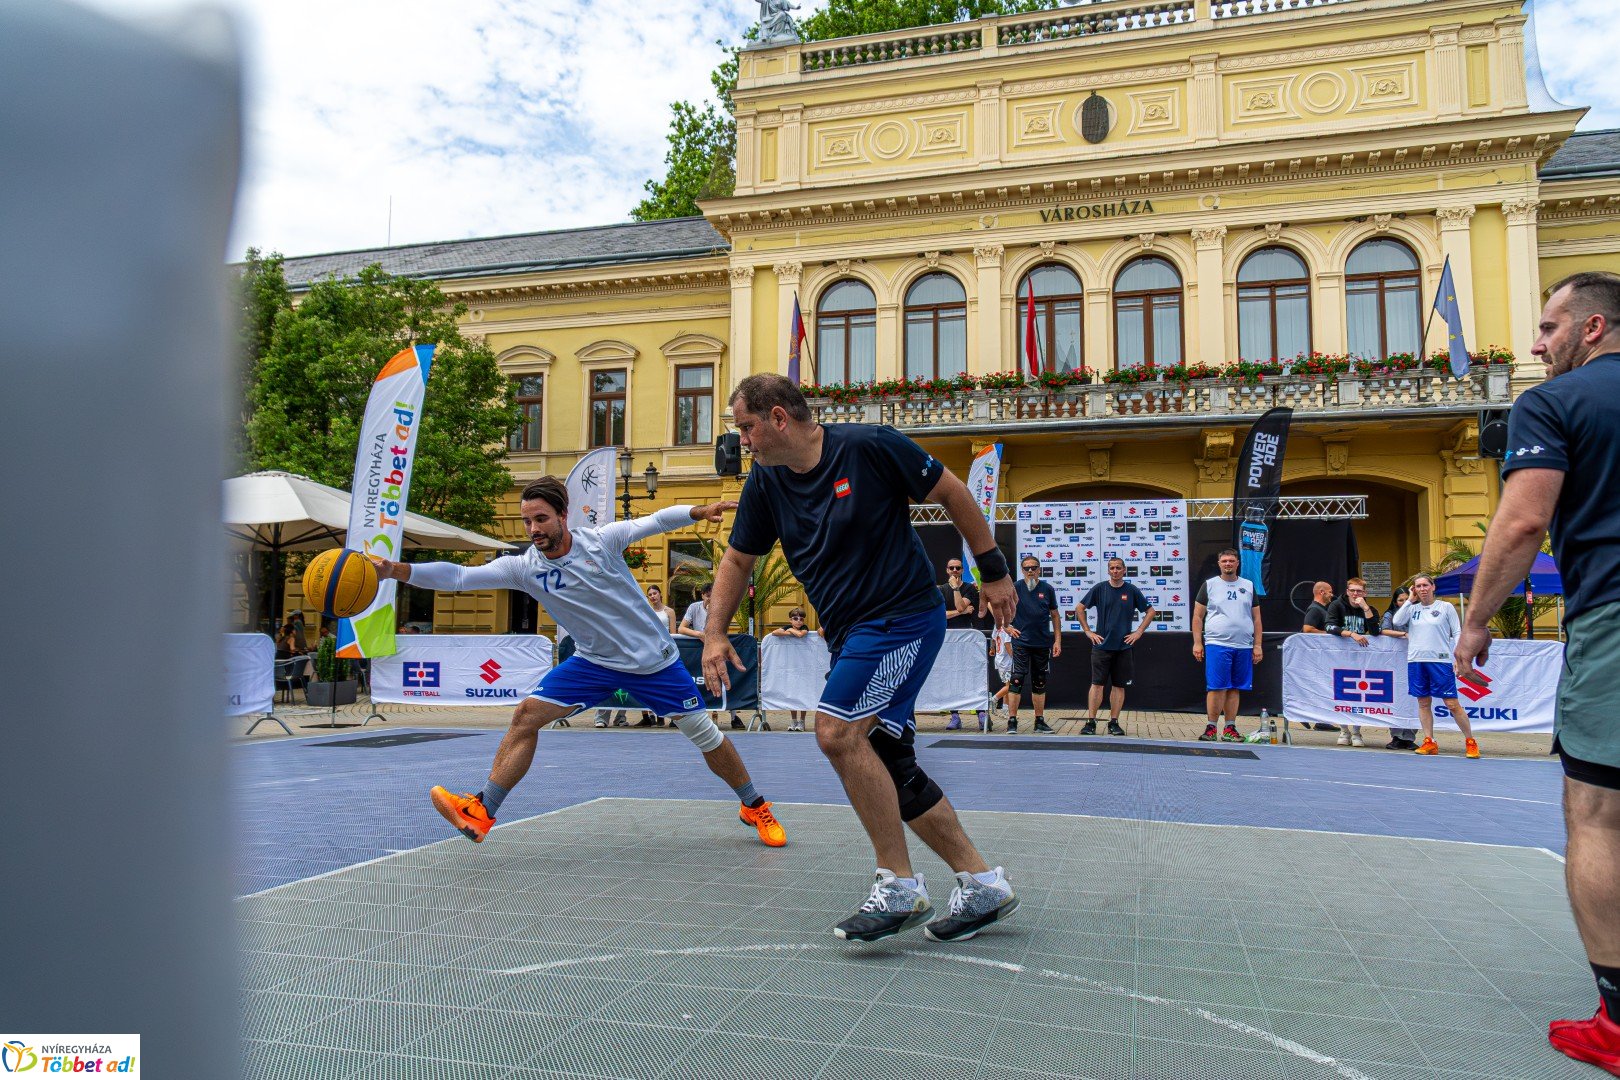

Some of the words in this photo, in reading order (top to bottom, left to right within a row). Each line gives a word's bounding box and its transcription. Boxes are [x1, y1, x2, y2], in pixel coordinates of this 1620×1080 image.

[1040, 198, 1154, 222] VÁROSHÁZA
[1248, 432, 1268, 488] POWER
[1264, 434, 1280, 466] ADE
[380, 445, 408, 529] Többet
[394, 401, 415, 442] ad!
[364, 433, 387, 528] NYÍREGYHÁZA
[536, 568, 566, 593] 72
[1227, 591, 1237, 600] 24
[1412, 611, 1421, 620] 41
[465, 688, 518, 698] SUZUKI
